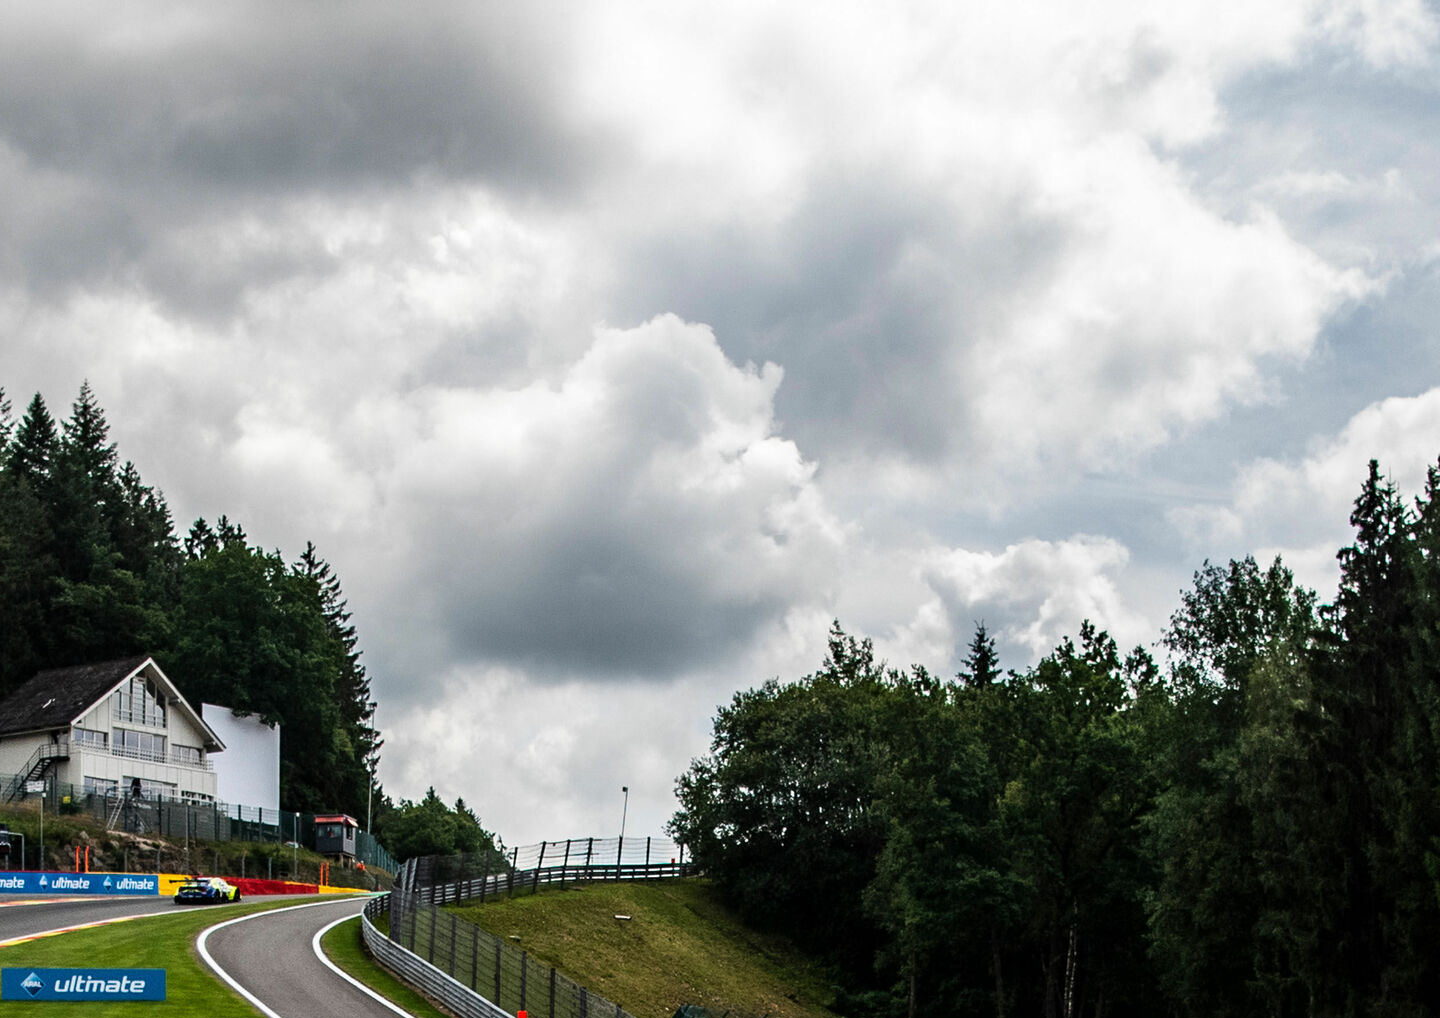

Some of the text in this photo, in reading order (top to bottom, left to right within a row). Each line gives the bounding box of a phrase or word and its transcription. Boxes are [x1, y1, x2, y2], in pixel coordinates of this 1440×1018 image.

[51, 877, 90, 889] ultimate
[116, 878, 154, 890] ultimate
[54, 975, 146, 993] ultimate
